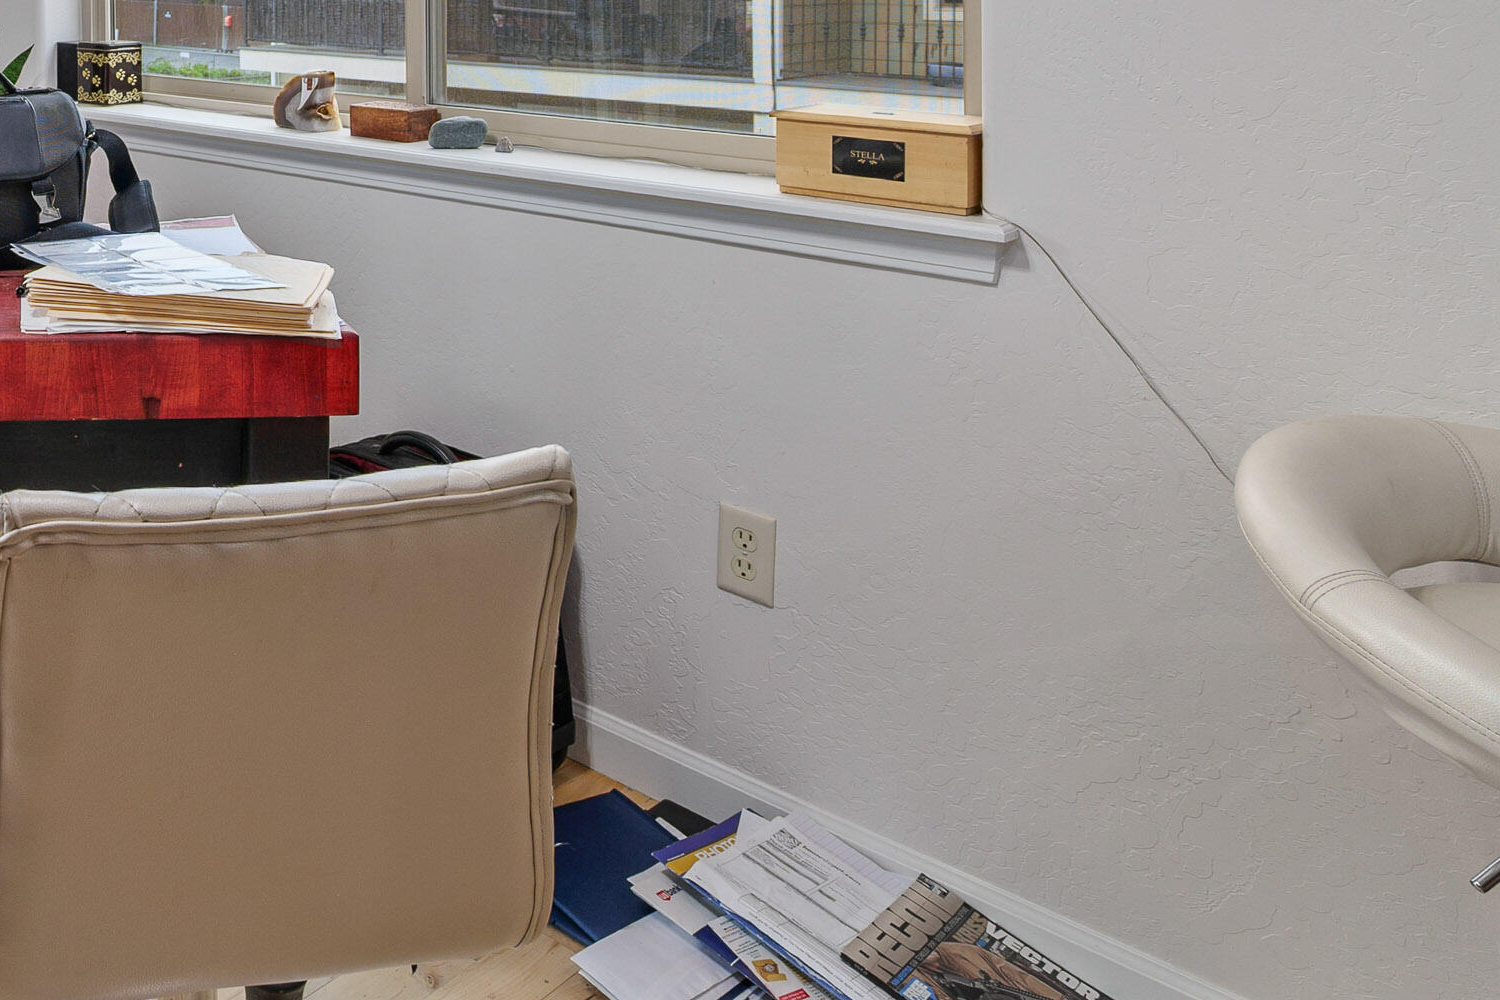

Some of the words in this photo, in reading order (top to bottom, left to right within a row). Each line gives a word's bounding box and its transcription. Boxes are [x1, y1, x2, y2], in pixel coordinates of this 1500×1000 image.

[850, 149, 885, 161] STELLA
[841, 880, 965, 985] RECOIL
[986, 920, 1100, 1000] VECTOR
